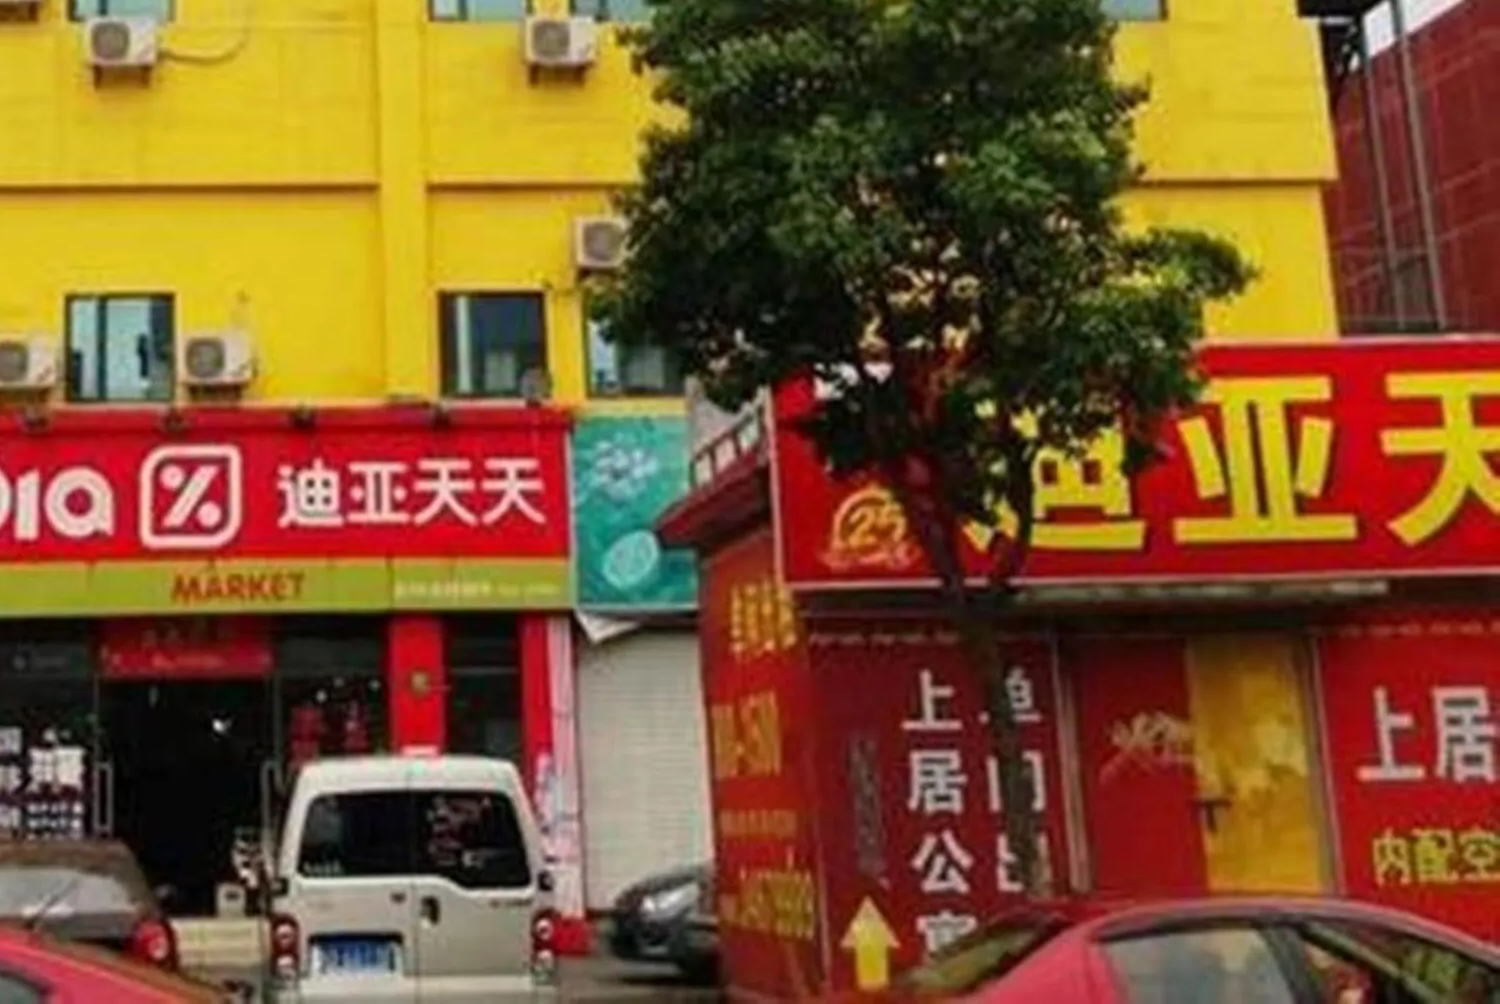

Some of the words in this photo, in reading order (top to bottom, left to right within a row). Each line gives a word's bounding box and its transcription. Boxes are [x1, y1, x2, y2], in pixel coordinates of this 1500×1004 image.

[278, 458, 547, 529] 迪亚天天
[171, 573, 305, 605] MARKET
[1357, 685, 1498, 782] 上居
